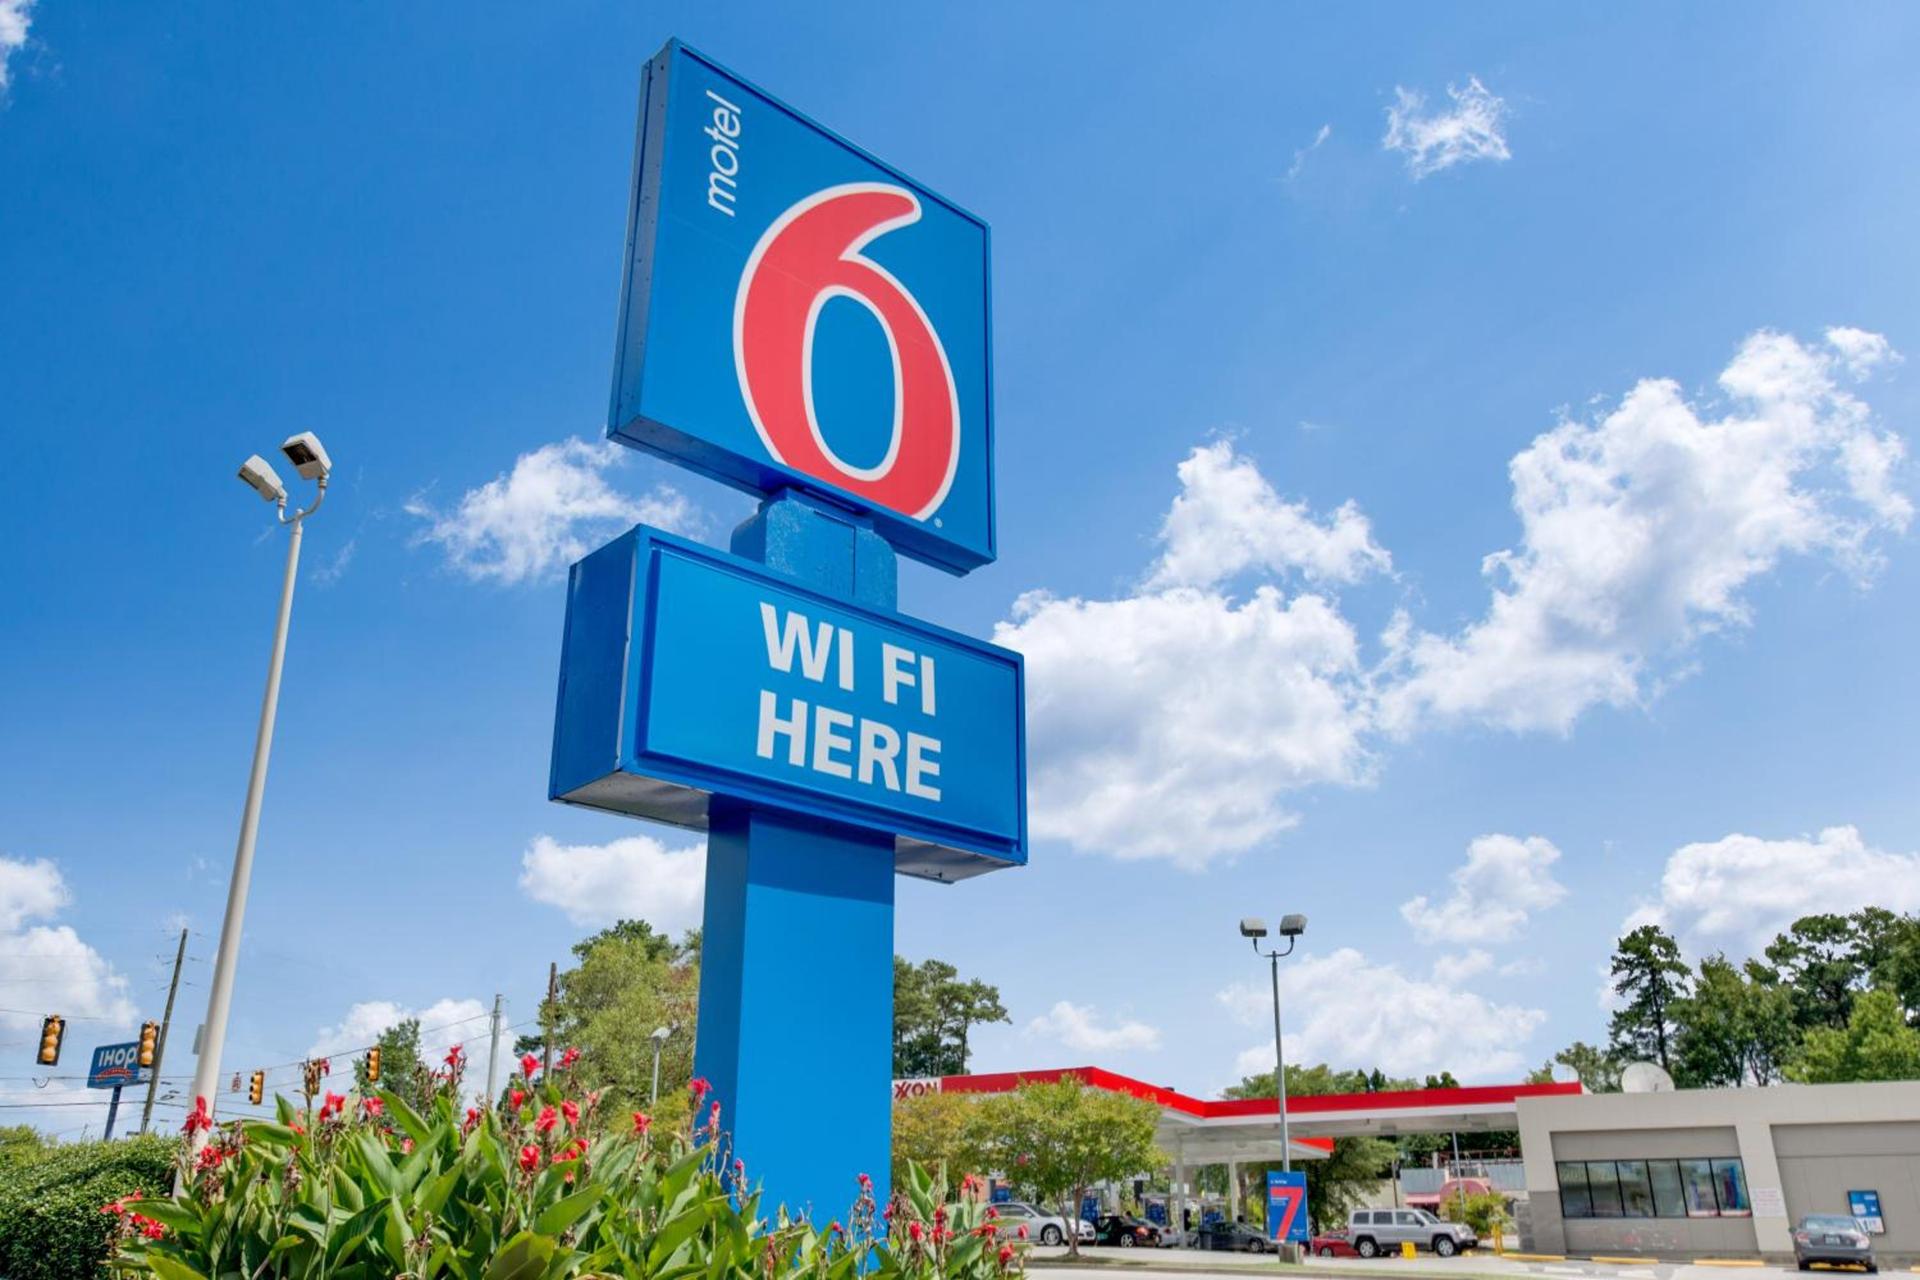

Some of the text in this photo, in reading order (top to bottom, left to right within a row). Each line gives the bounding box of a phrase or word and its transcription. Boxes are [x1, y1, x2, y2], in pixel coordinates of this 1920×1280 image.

[704, 90, 742, 218] motel
[733, 181, 961, 523] 6
[760, 601, 937, 717] WI FI
[756, 689, 942, 802] HERE
[894, 1081, 937, 1100] XXON
